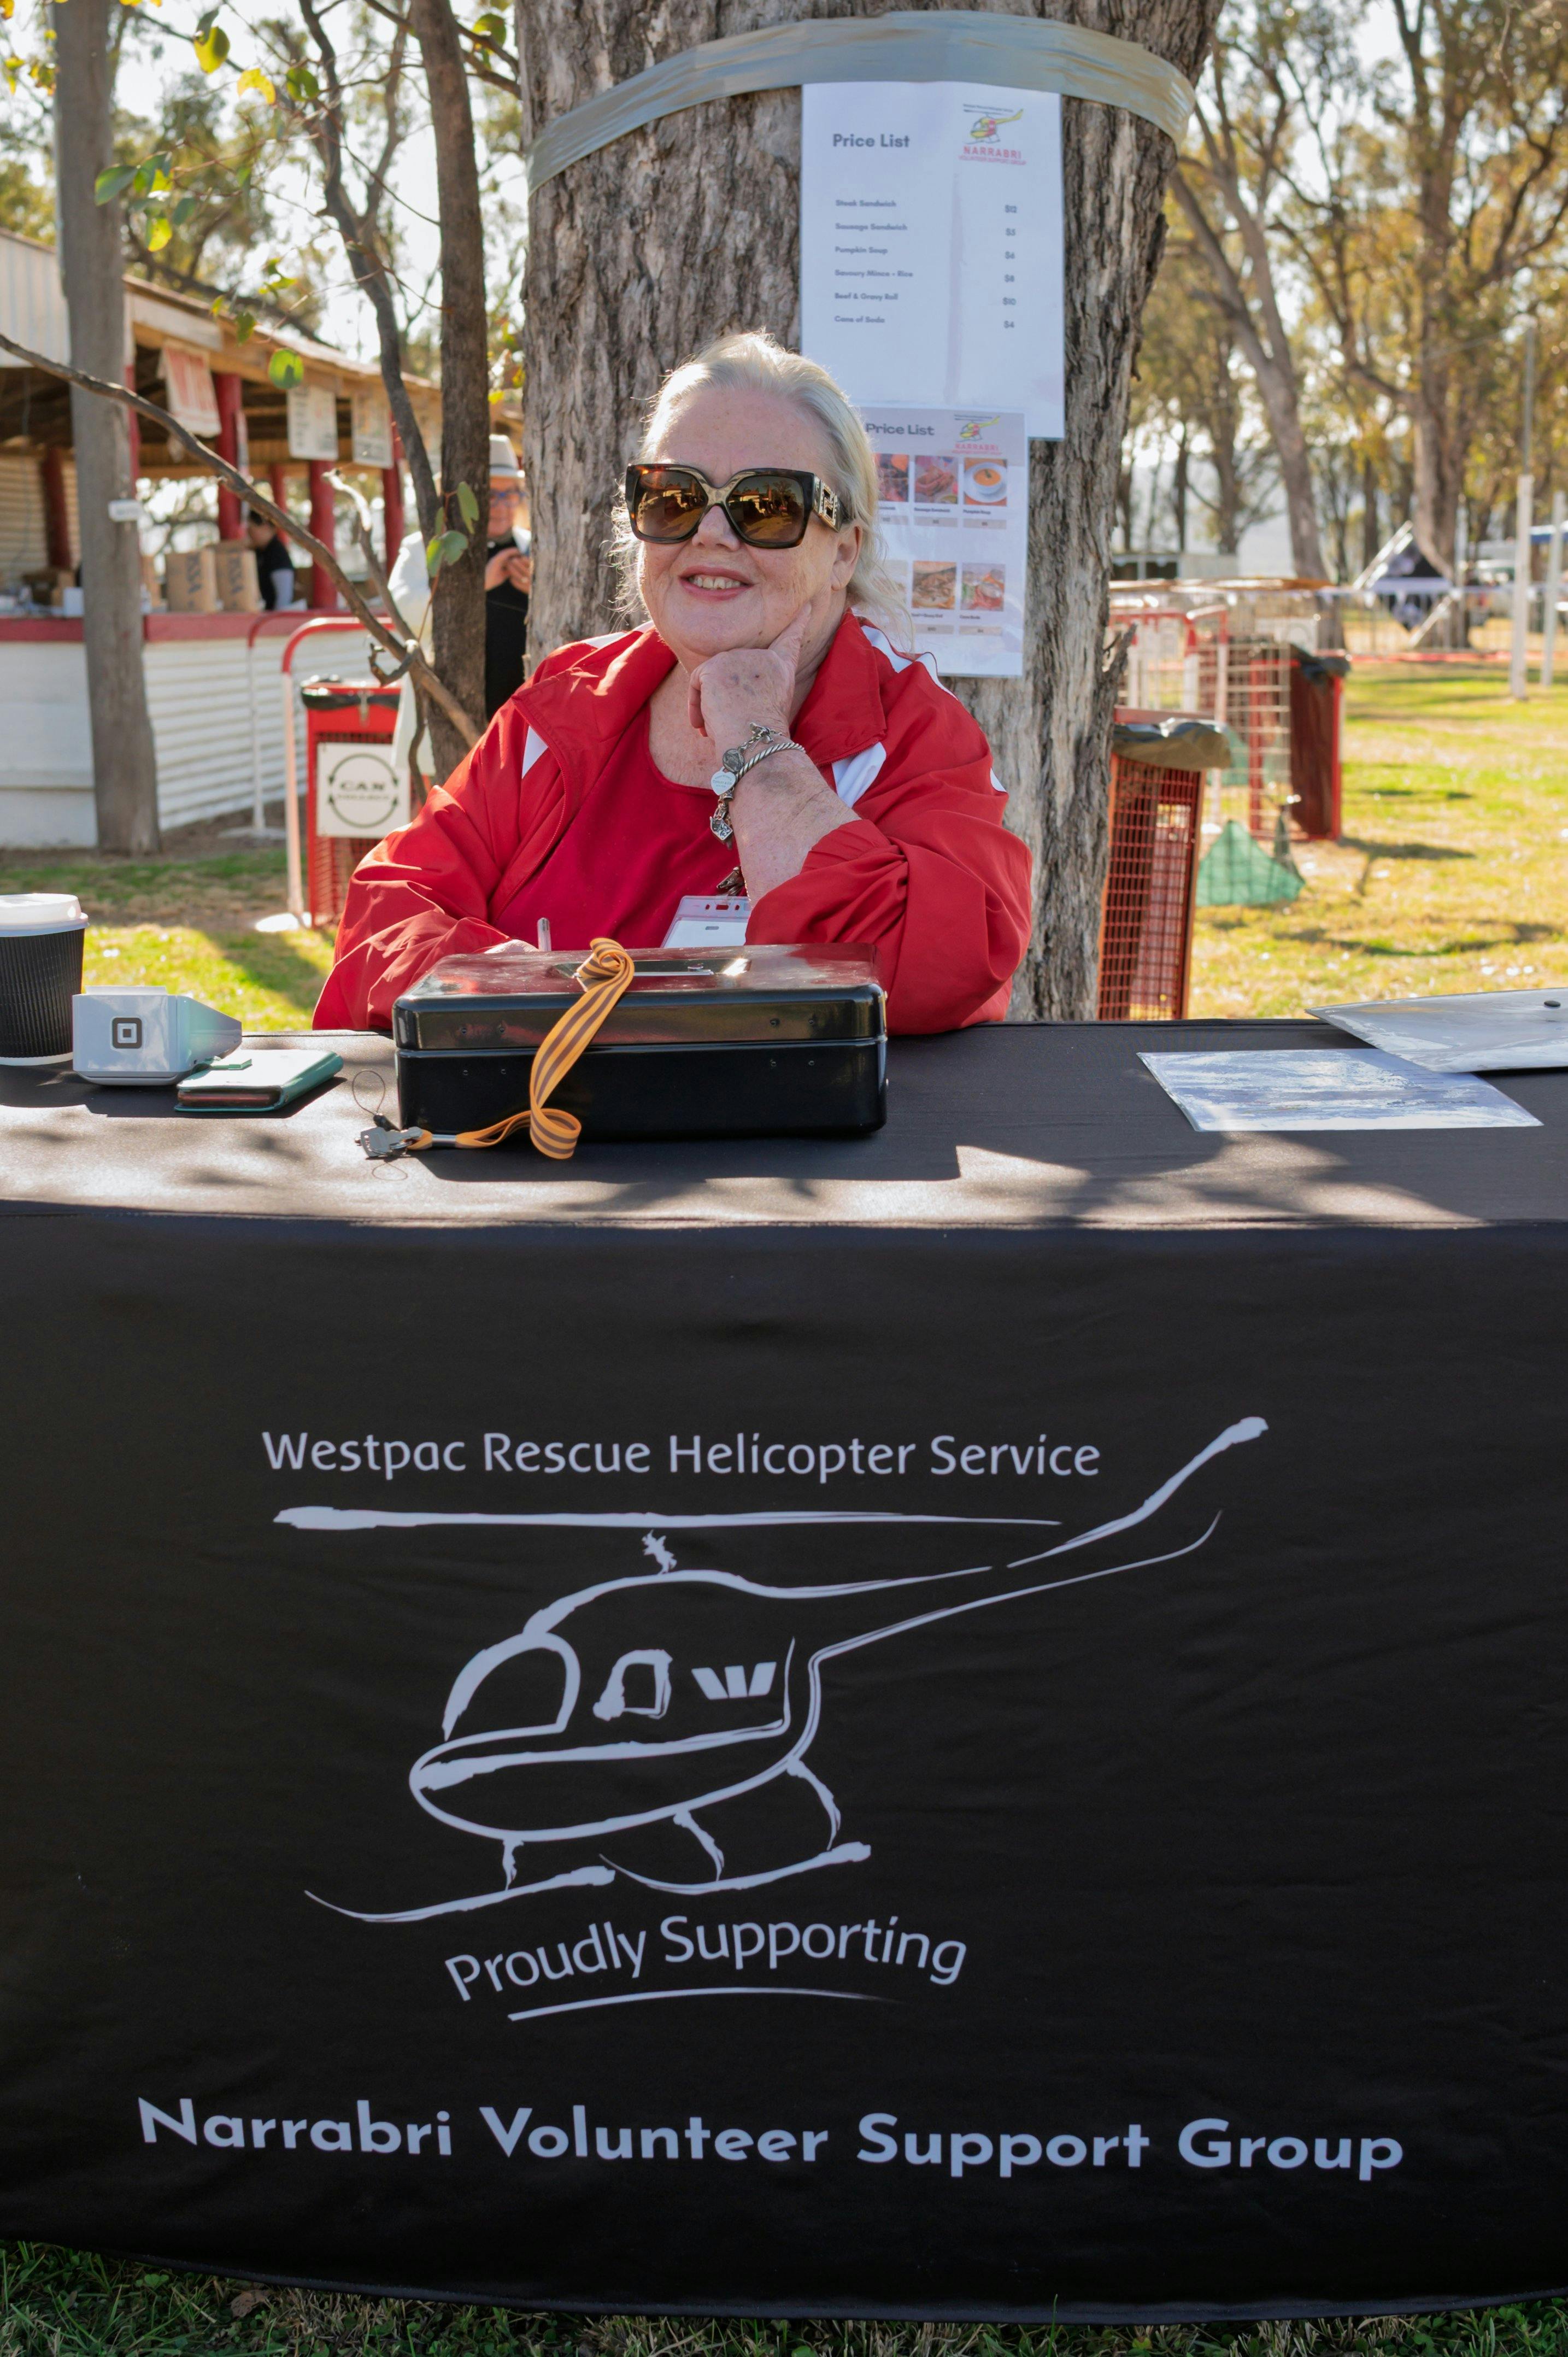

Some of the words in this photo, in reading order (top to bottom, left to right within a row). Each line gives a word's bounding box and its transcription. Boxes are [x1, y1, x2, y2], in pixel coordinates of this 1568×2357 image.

[832, 133, 875, 148] Price
[880, 134, 910, 148] List
[964, 145, 1021, 159] NARRABRI
[835, 223, 868, 231] Sausage
[835, 246, 867, 254] Pumpkin
[868, 247, 888, 255] Soup
[835, 269, 865, 278] Savoury
[860, 293, 883, 301] Gravy
[866, 423, 905, 435] Price
[907, 424, 935, 436] List
[339, 782, 385, 791] CAN
[262, 1432, 466, 1480] Westpac
[484, 1433, 650, 1473] Rescue
[670, 1433, 916, 1484] Helicopter
[931, 1434, 1100, 1475] Service
[445, 1921, 646, 2001] Proudly
[660, 1916, 966, 1985] Supporting
[139, 2098, 451, 2155] Narrabri
[479, 2105, 828, 2161] Volunteer
[858, 2113, 1149, 2177] Support
[1178, 2118, 1402, 2180] Group
